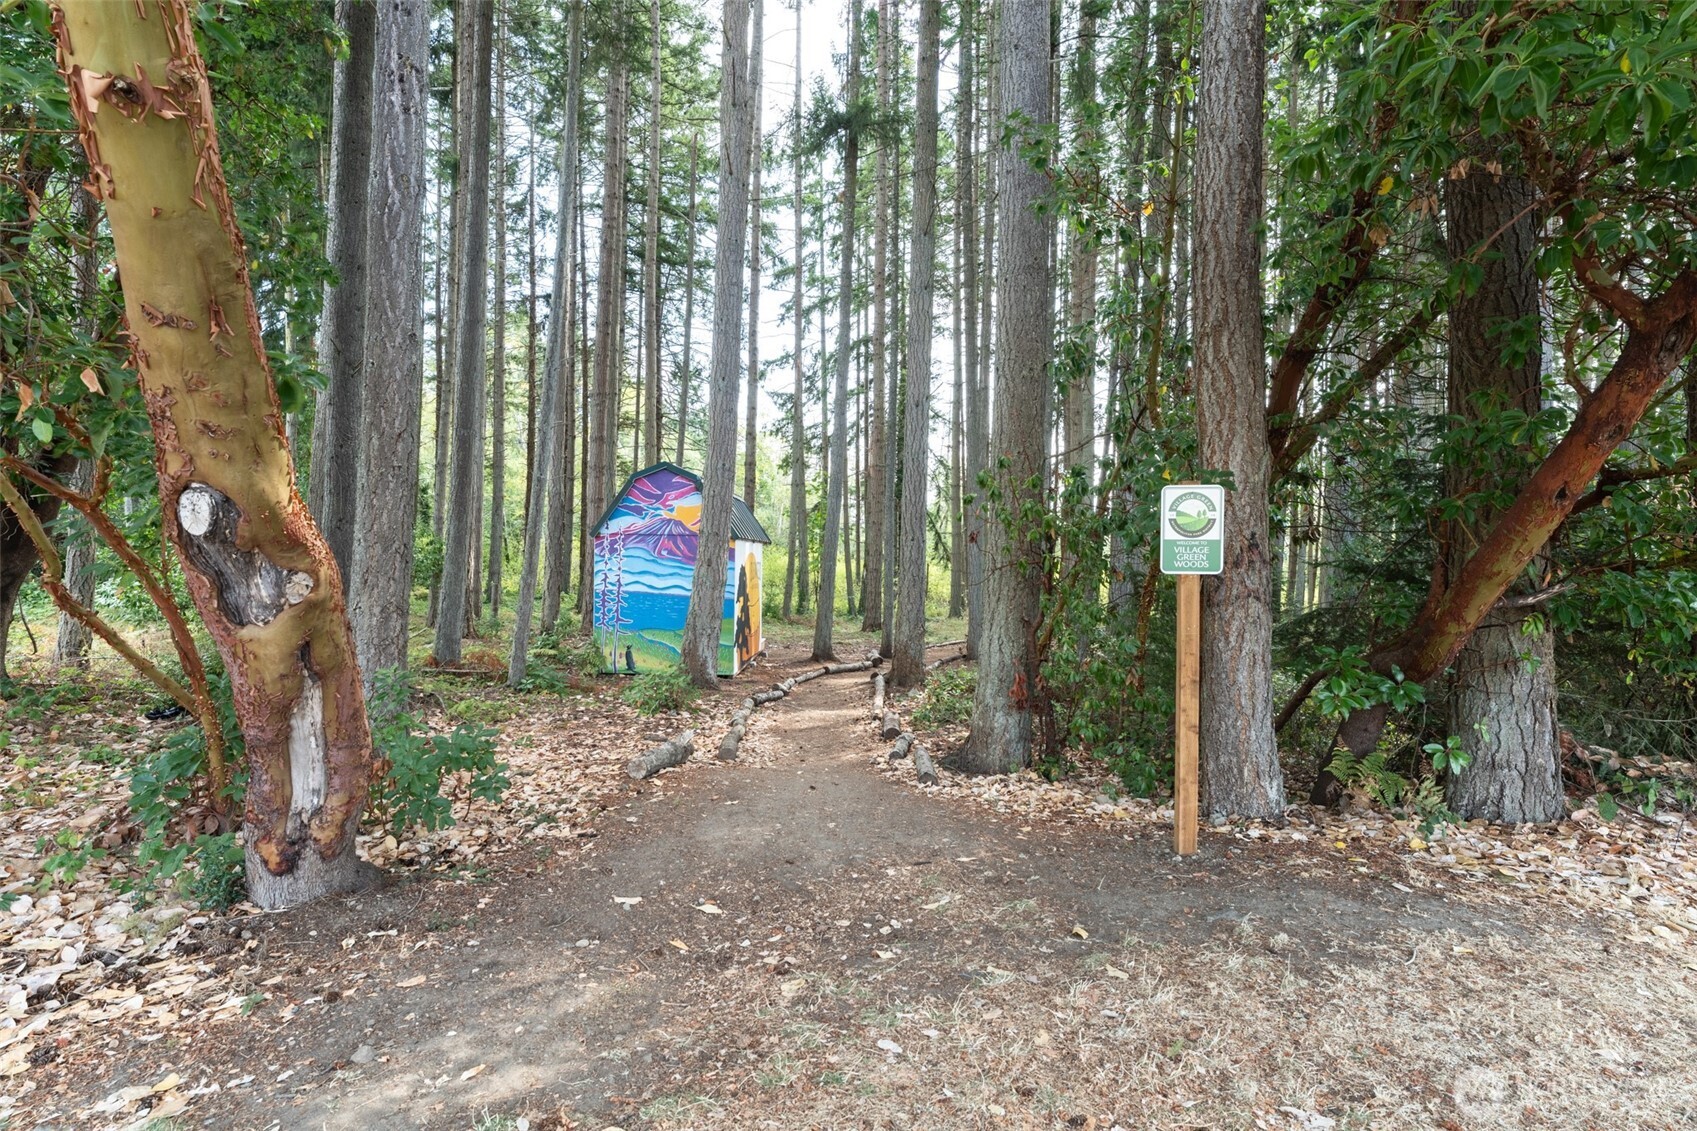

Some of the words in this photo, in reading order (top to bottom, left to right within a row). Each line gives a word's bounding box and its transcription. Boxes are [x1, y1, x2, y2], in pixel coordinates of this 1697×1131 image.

[1171, 494, 1194, 509] VILLAGE
[1196, 494, 1214, 510] GREEN
[1173, 546, 1210, 554] VILLAGE
[1176, 553, 1207, 561] GREEN
[1173, 560, 1209, 568] WOODS
